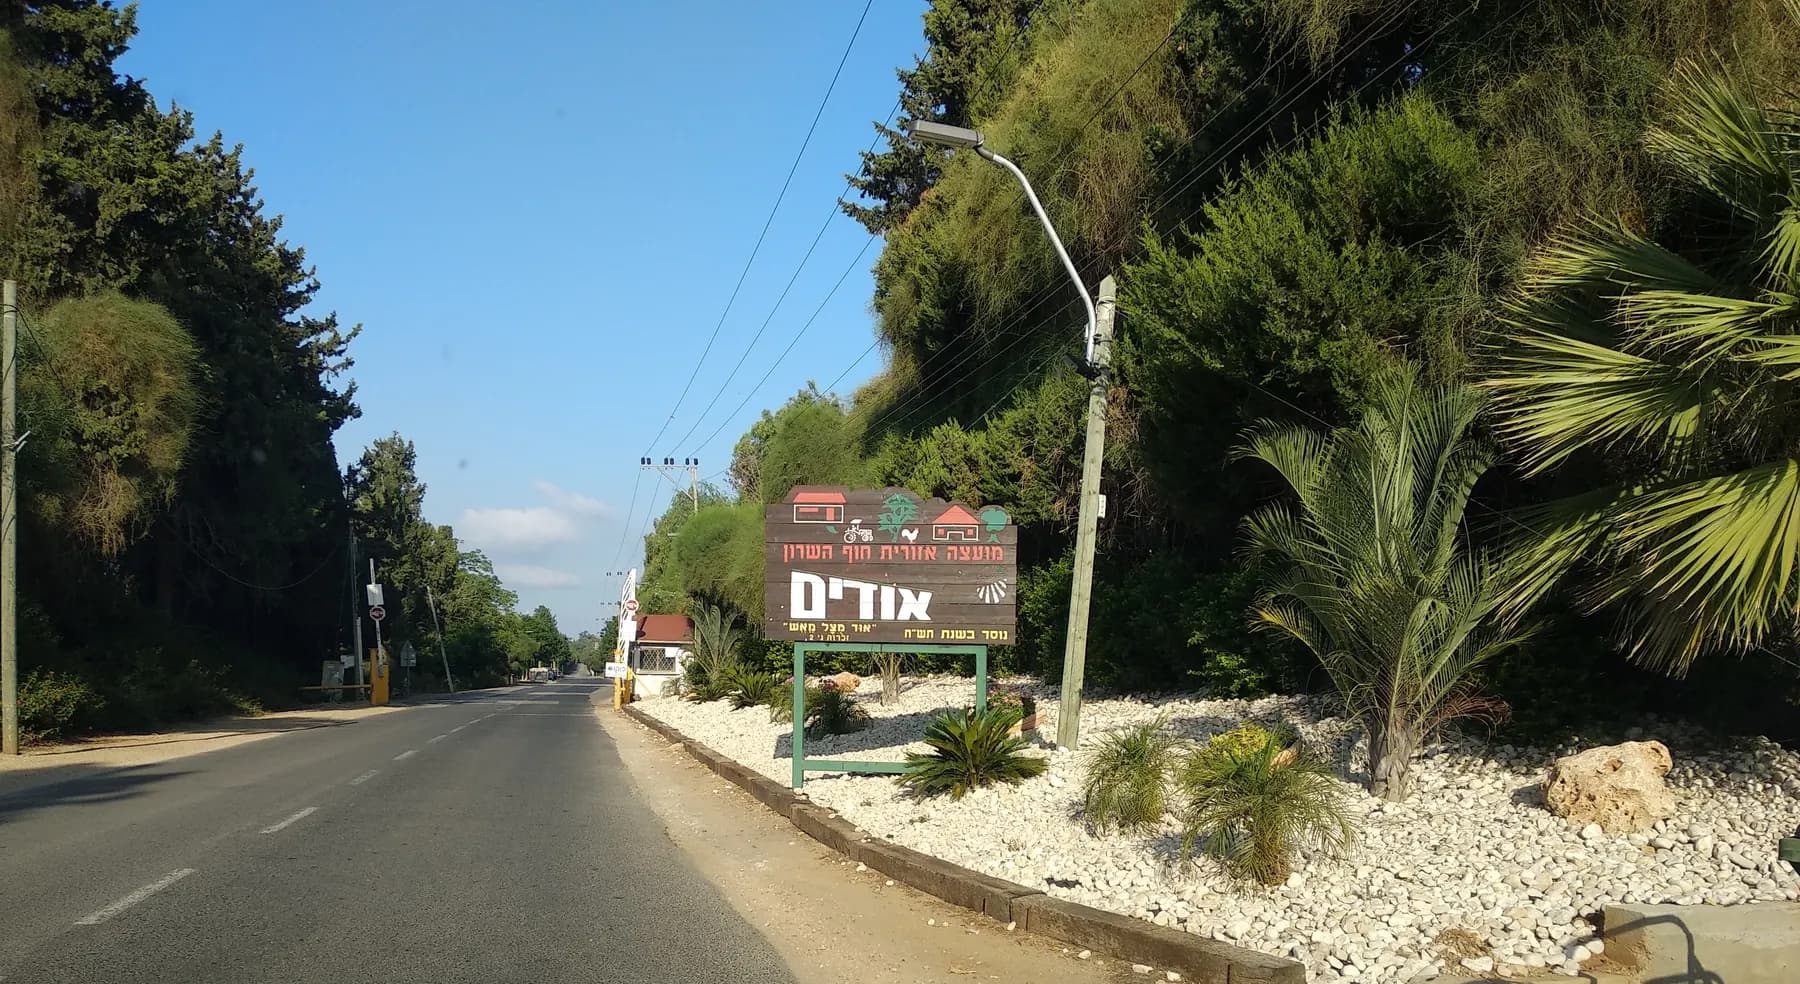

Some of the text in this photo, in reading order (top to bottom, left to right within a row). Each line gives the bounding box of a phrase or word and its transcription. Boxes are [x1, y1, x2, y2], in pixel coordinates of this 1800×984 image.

[783, 544, 1004, 563] מועצה אזורית חוף השרון
[790, 570, 933, 621] אודים
[940, 629, 975, 640] בשנת
[981, 630, 1008, 640] נוסד
